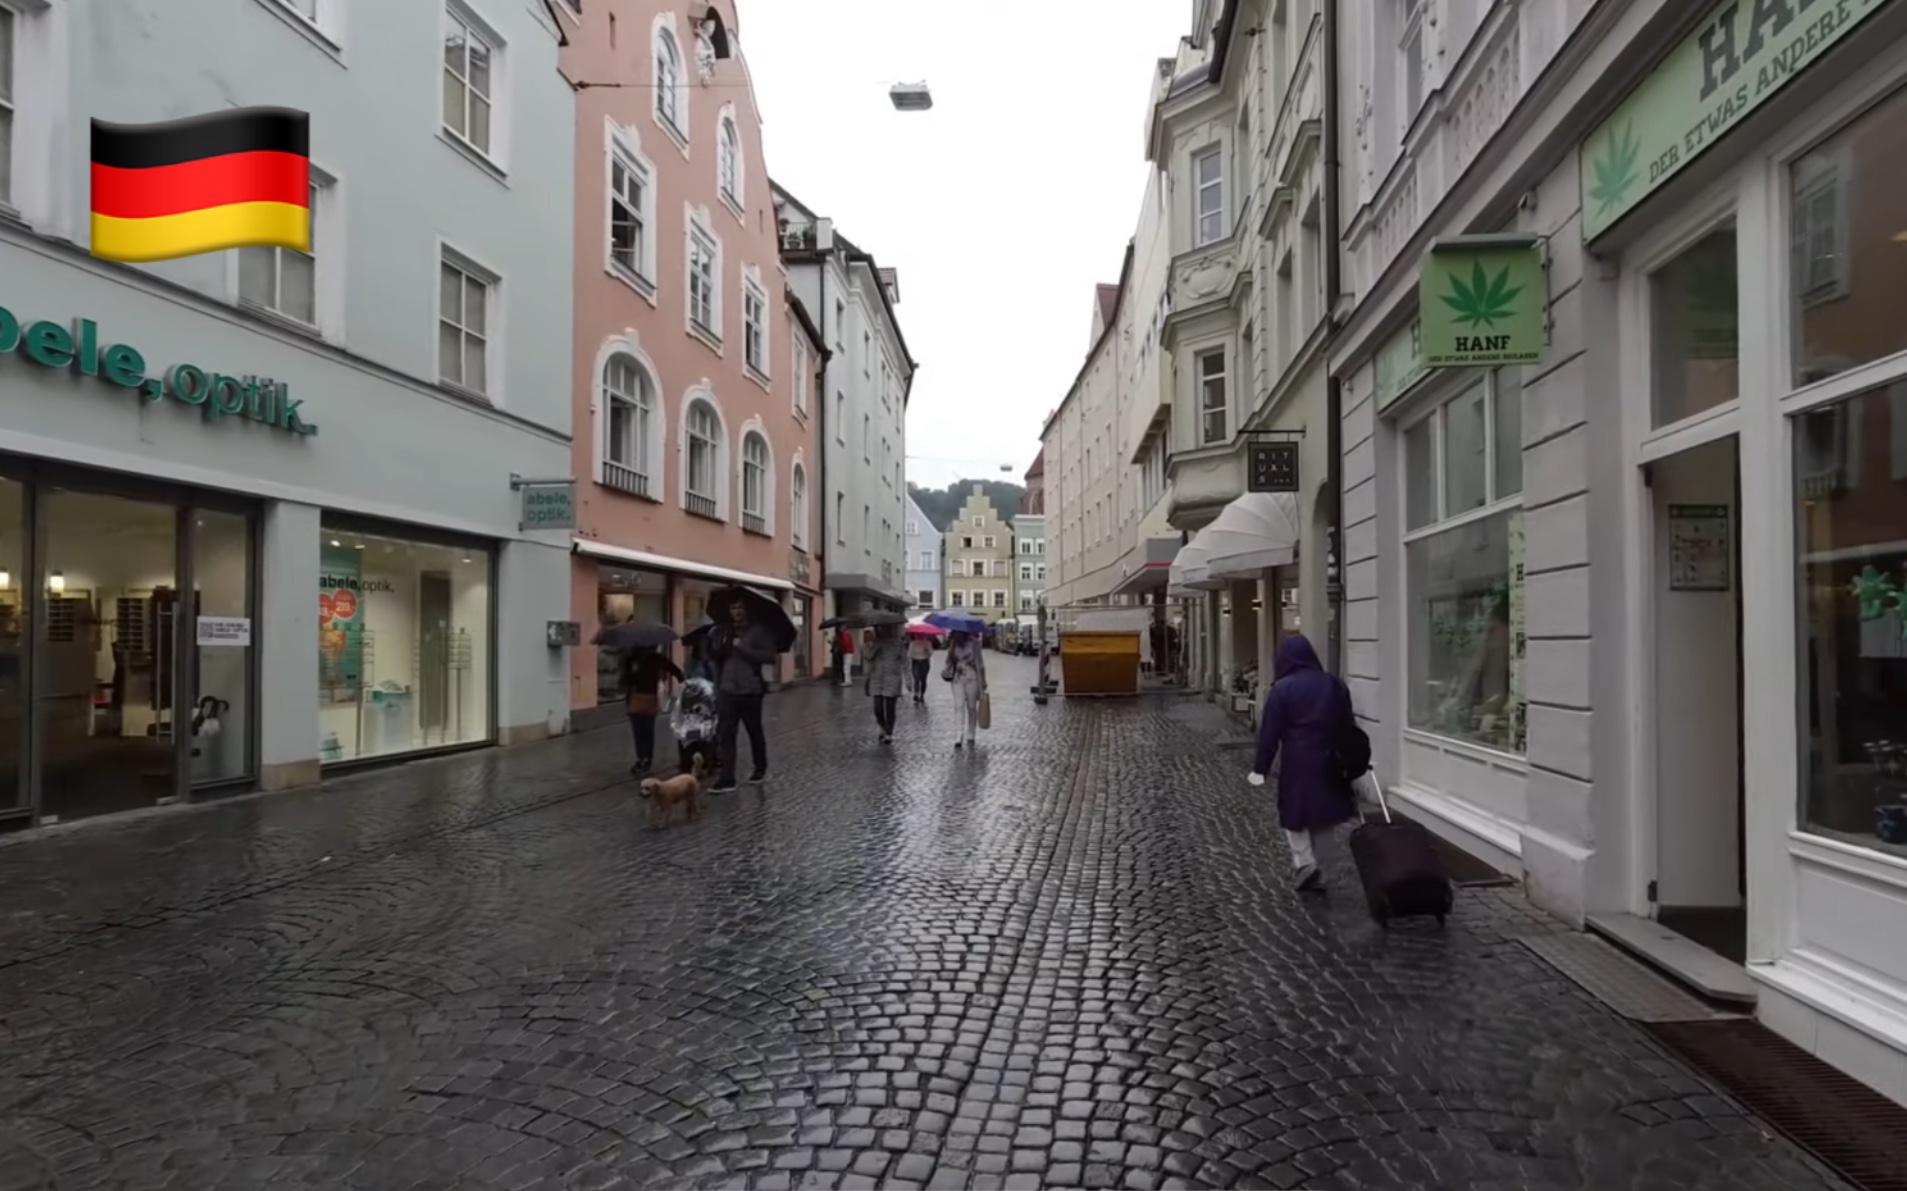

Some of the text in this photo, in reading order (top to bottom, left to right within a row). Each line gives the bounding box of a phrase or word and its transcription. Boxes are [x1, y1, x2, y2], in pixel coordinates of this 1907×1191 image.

[1649, 1, 1852, 184] DER ETWAS ANDERE
[1698, 0, 1823, 103] HA
[1455, 335, 1511, 352] HANF
